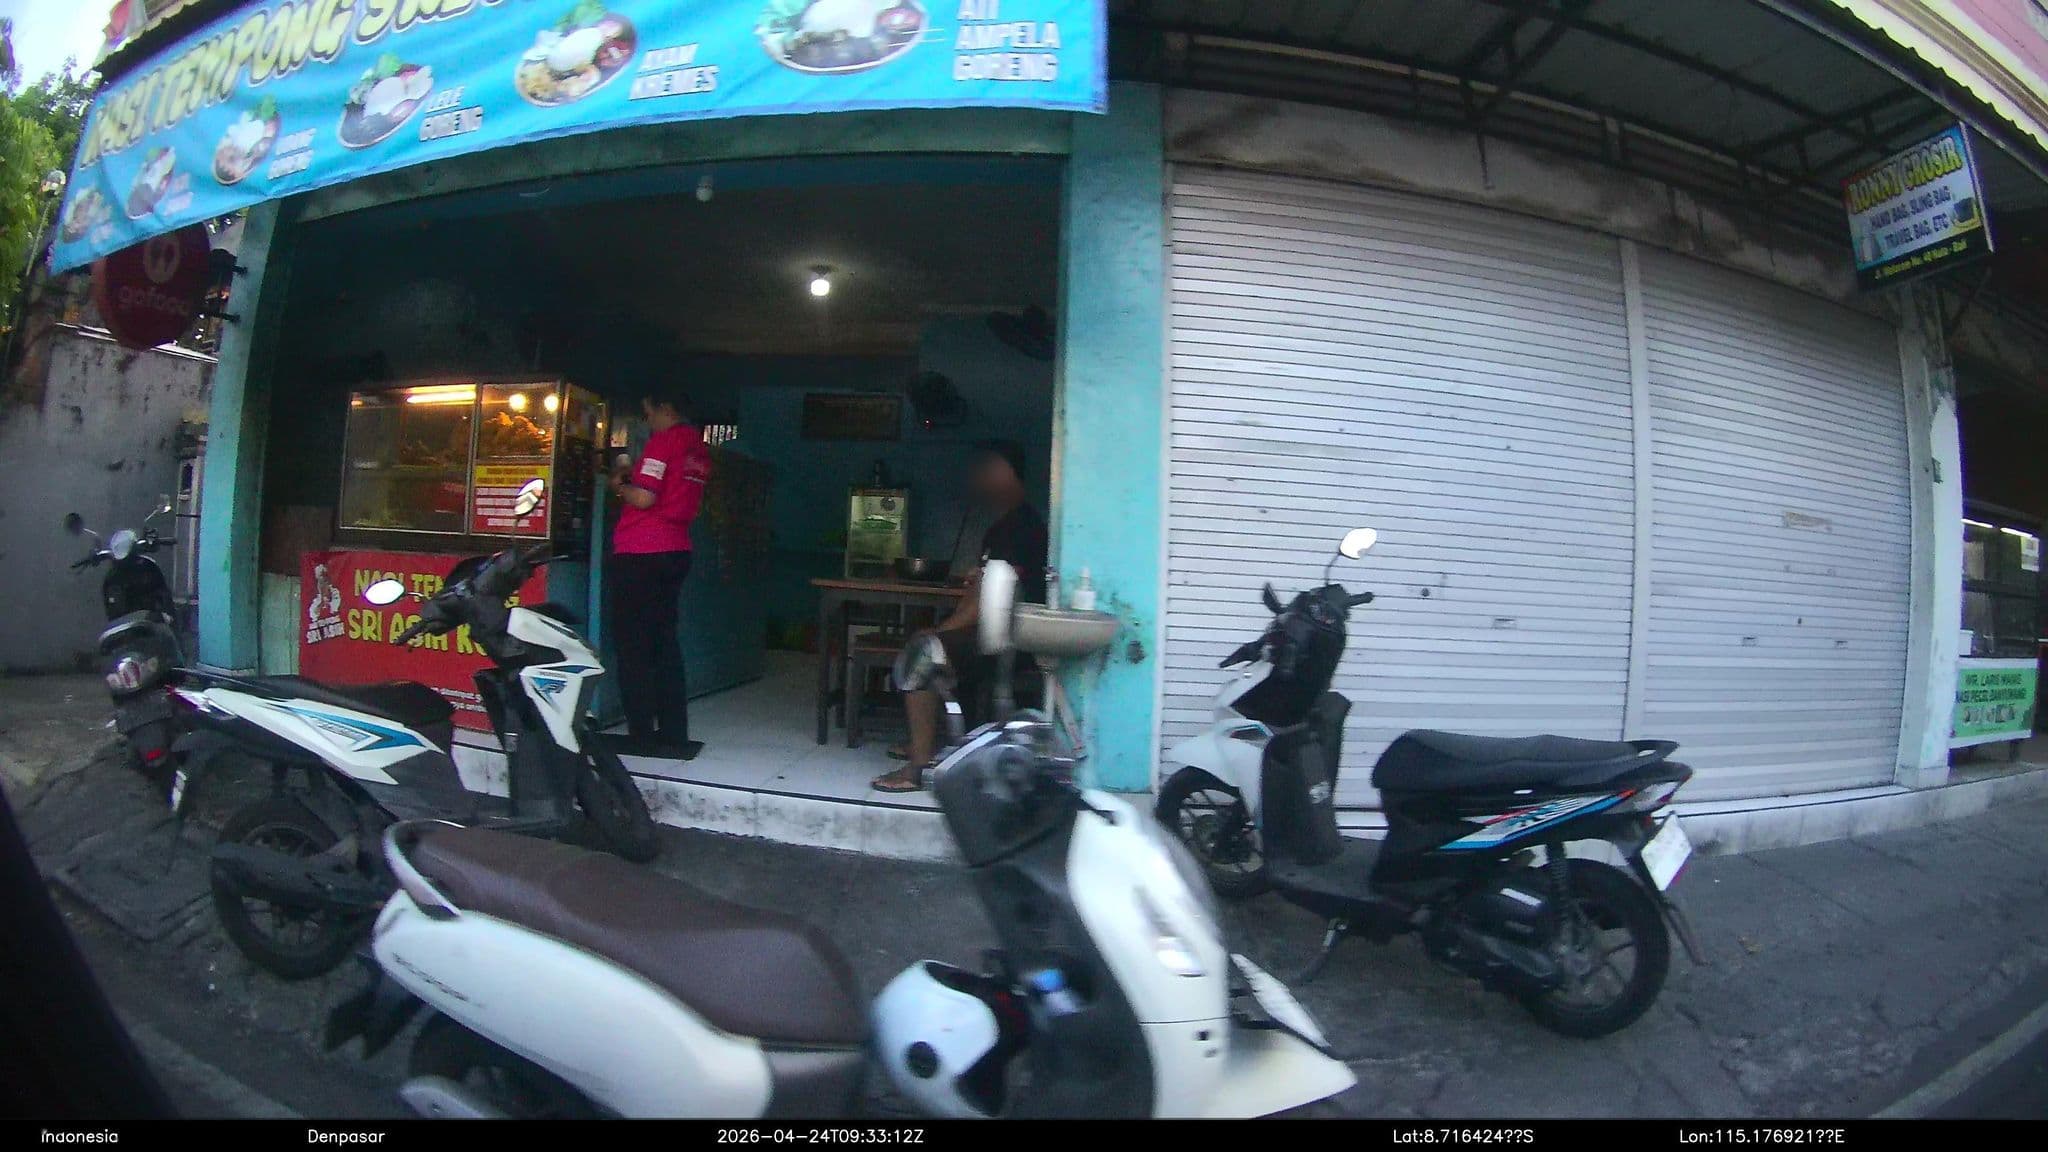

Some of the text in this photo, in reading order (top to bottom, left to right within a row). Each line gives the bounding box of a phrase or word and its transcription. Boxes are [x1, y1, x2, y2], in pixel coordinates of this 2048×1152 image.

[955, 21, 1061, 51] AMPELA
[149, 0, 354, 136] TEMPONG
[952, 52, 1060, 82] GORENG
[347, 608, 383, 642] SRI
